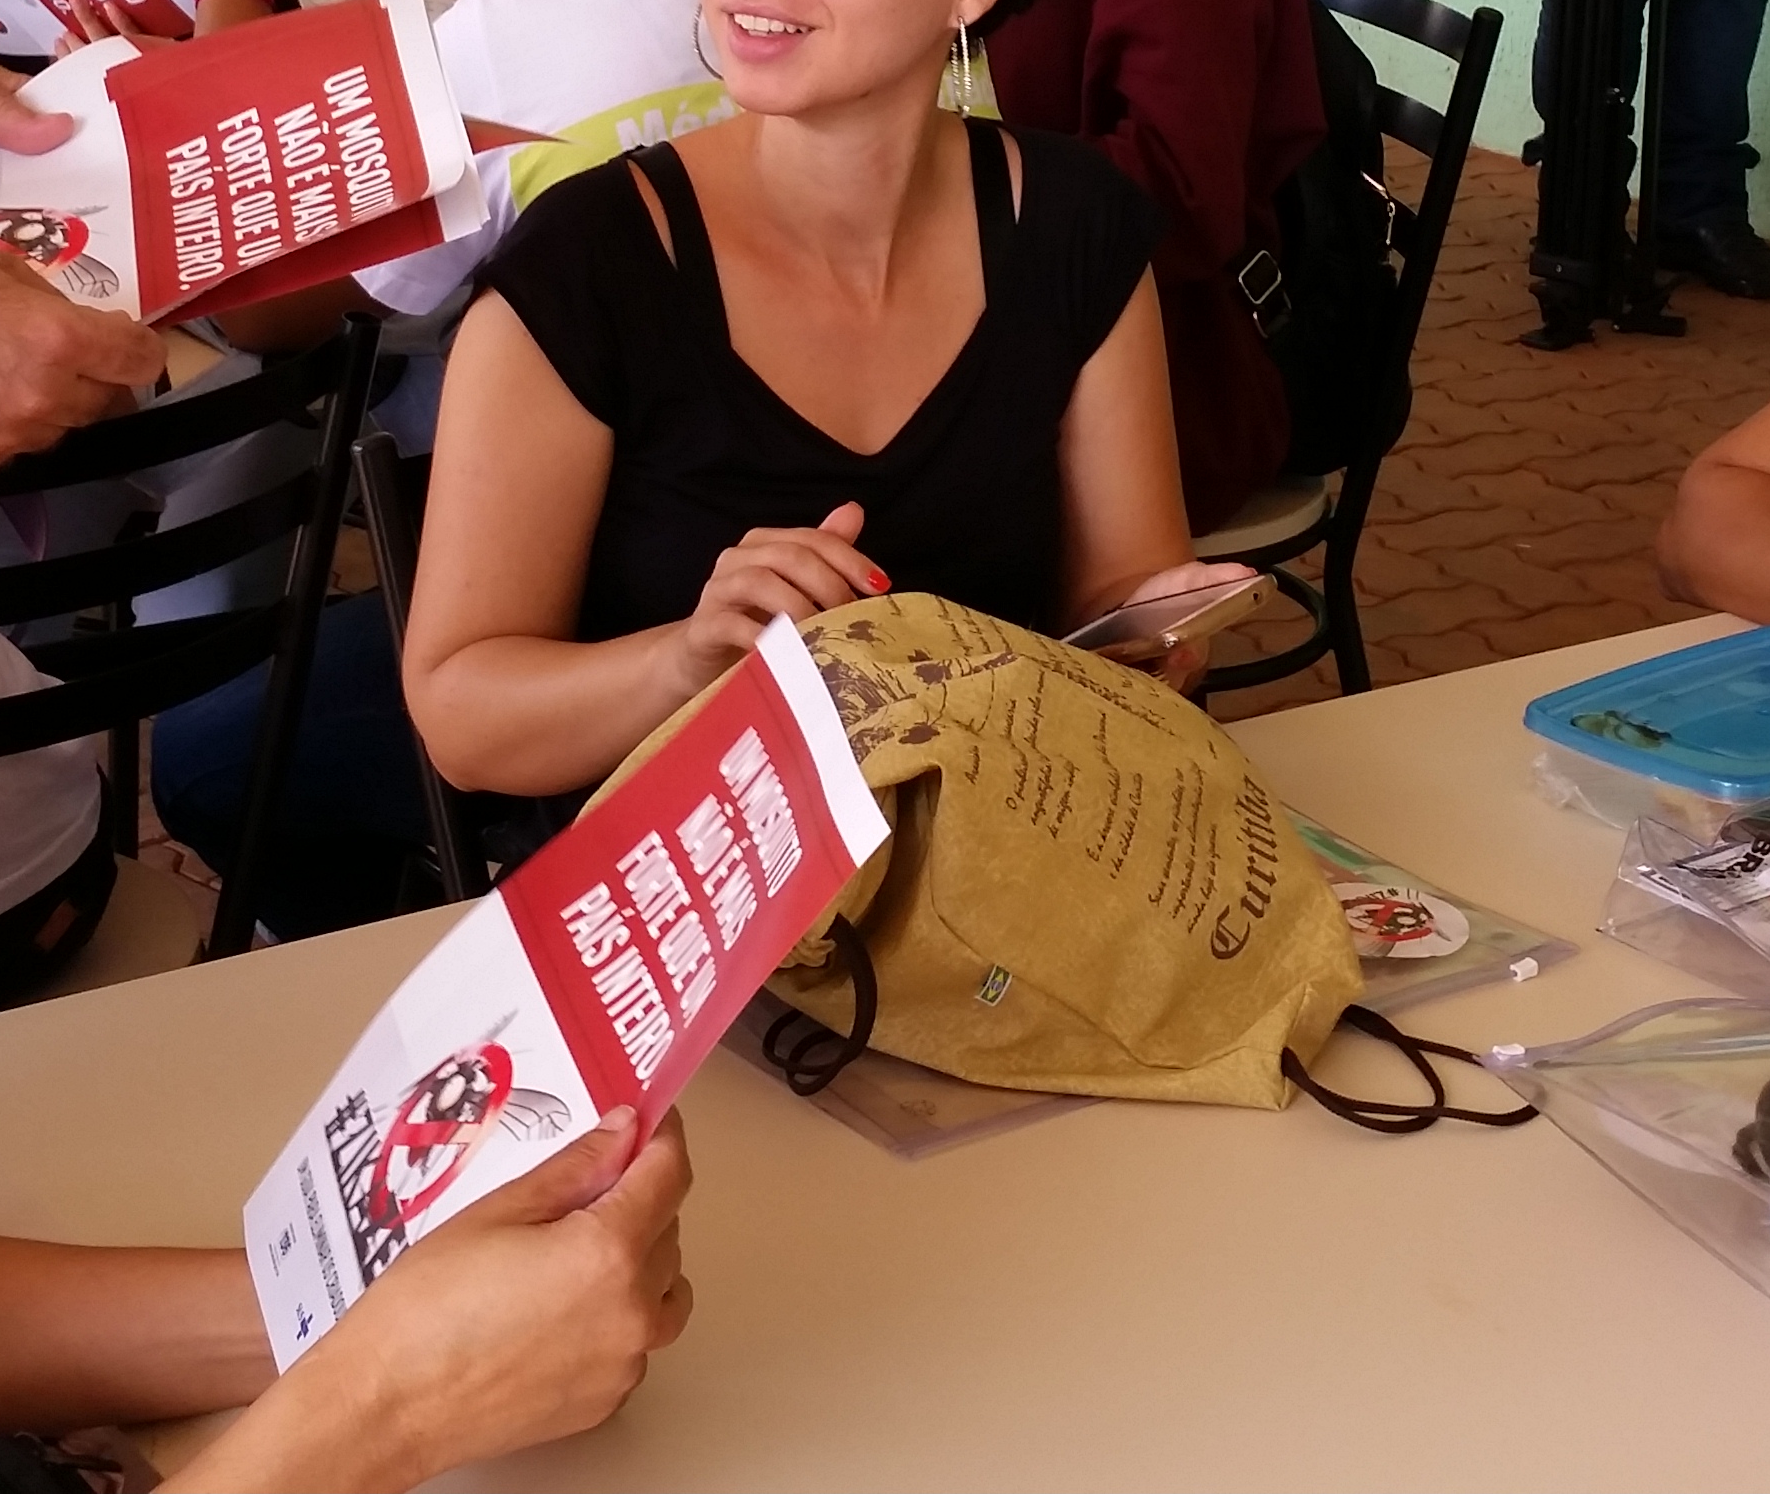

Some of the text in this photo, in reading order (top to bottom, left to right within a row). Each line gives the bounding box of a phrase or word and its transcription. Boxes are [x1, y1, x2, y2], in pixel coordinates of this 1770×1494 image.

[216, 106, 273, 196] FORTE
[323, 64, 373, 119] UM
[165, 135, 225, 291] PAÍS INTEIRO.
[230, 190, 280, 241] QUE
[273, 102, 341, 243] NÃO É MAIS
[675, 792, 735, 877] NÃO
[710, 861, 758, 951] MAIS
[718, 725, 803, 899] UM MOSQUITO
[1210, 772, 1279, 960] Curitiba
[559, 881, 676, 1091] PAÍS INTEIRO.
[615, 829, 693, 941] FORTE
[657, 909, 712, 993] QUE
